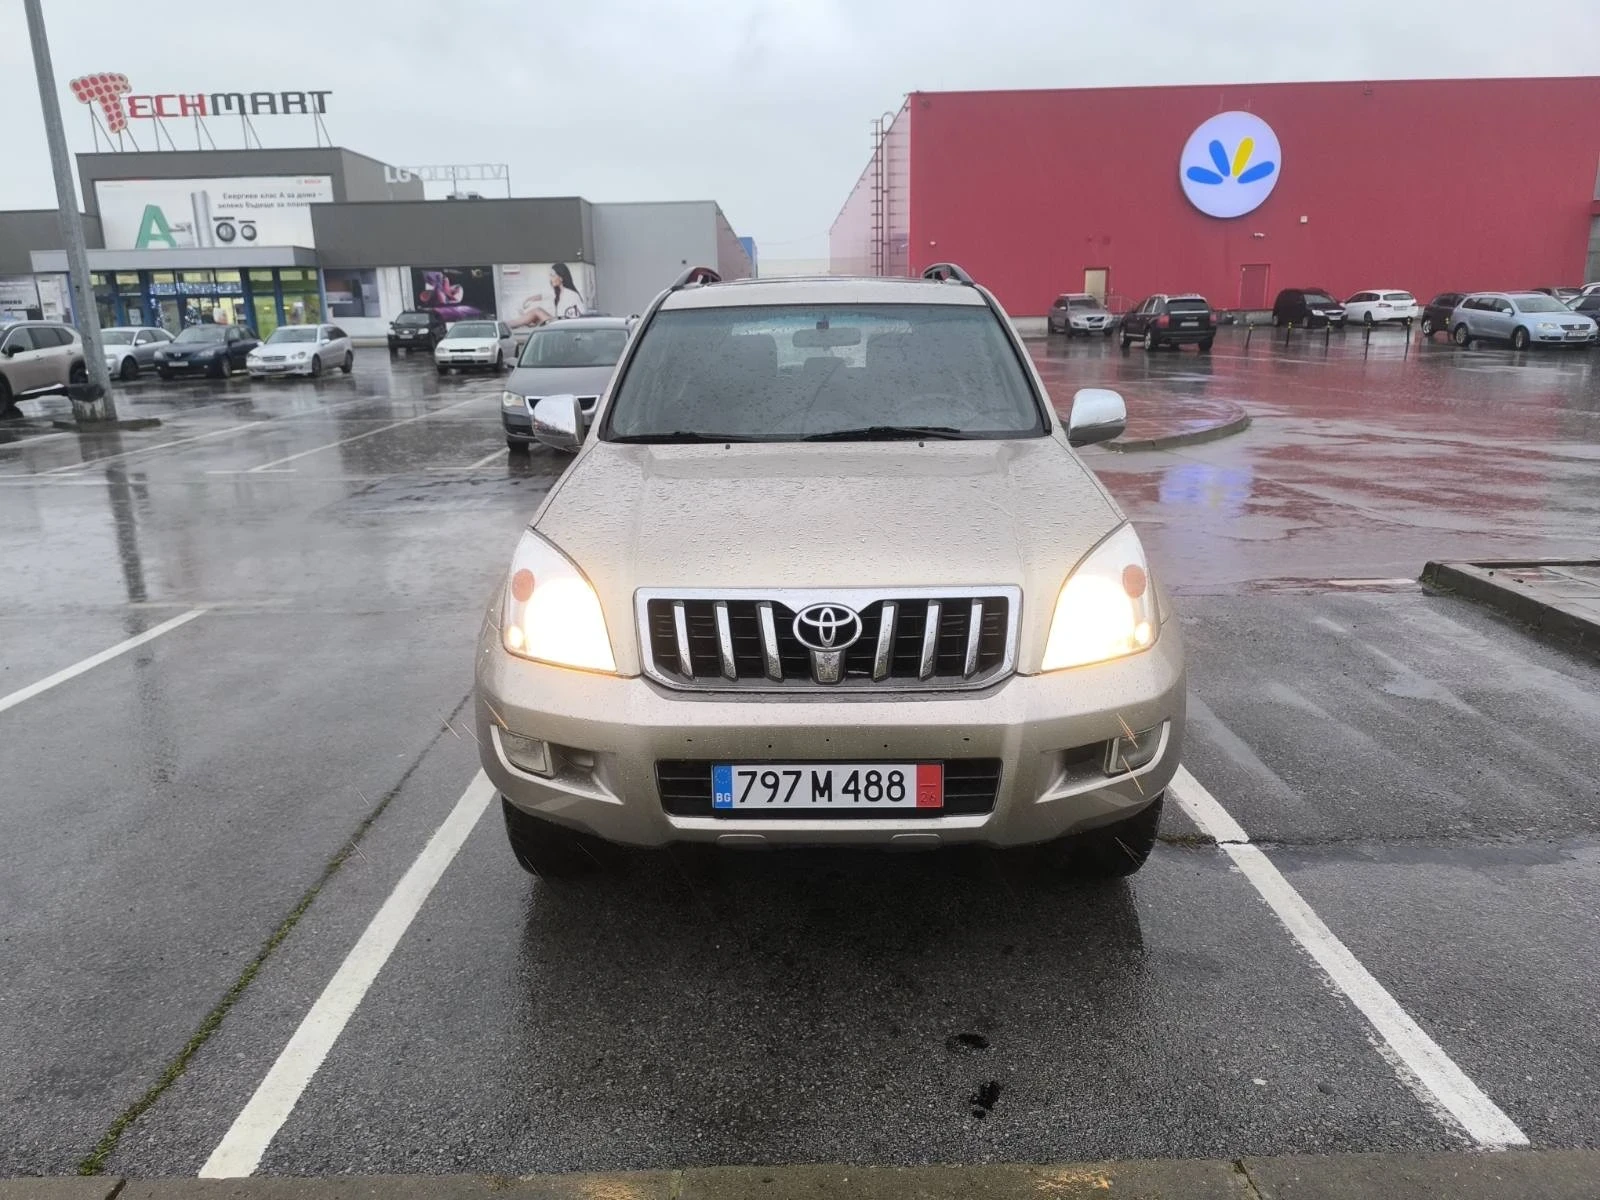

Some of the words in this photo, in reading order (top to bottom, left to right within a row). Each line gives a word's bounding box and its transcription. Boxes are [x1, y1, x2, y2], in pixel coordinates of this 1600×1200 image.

[69, 72, 333, 133] TECHMART
[384, 165, 412, 183] LG
[716, 792, 731, 803] BG
[738, 770, 802, 803] 797
[811, 770, 833, 803] M
[841, 769, 906, 803] 488
